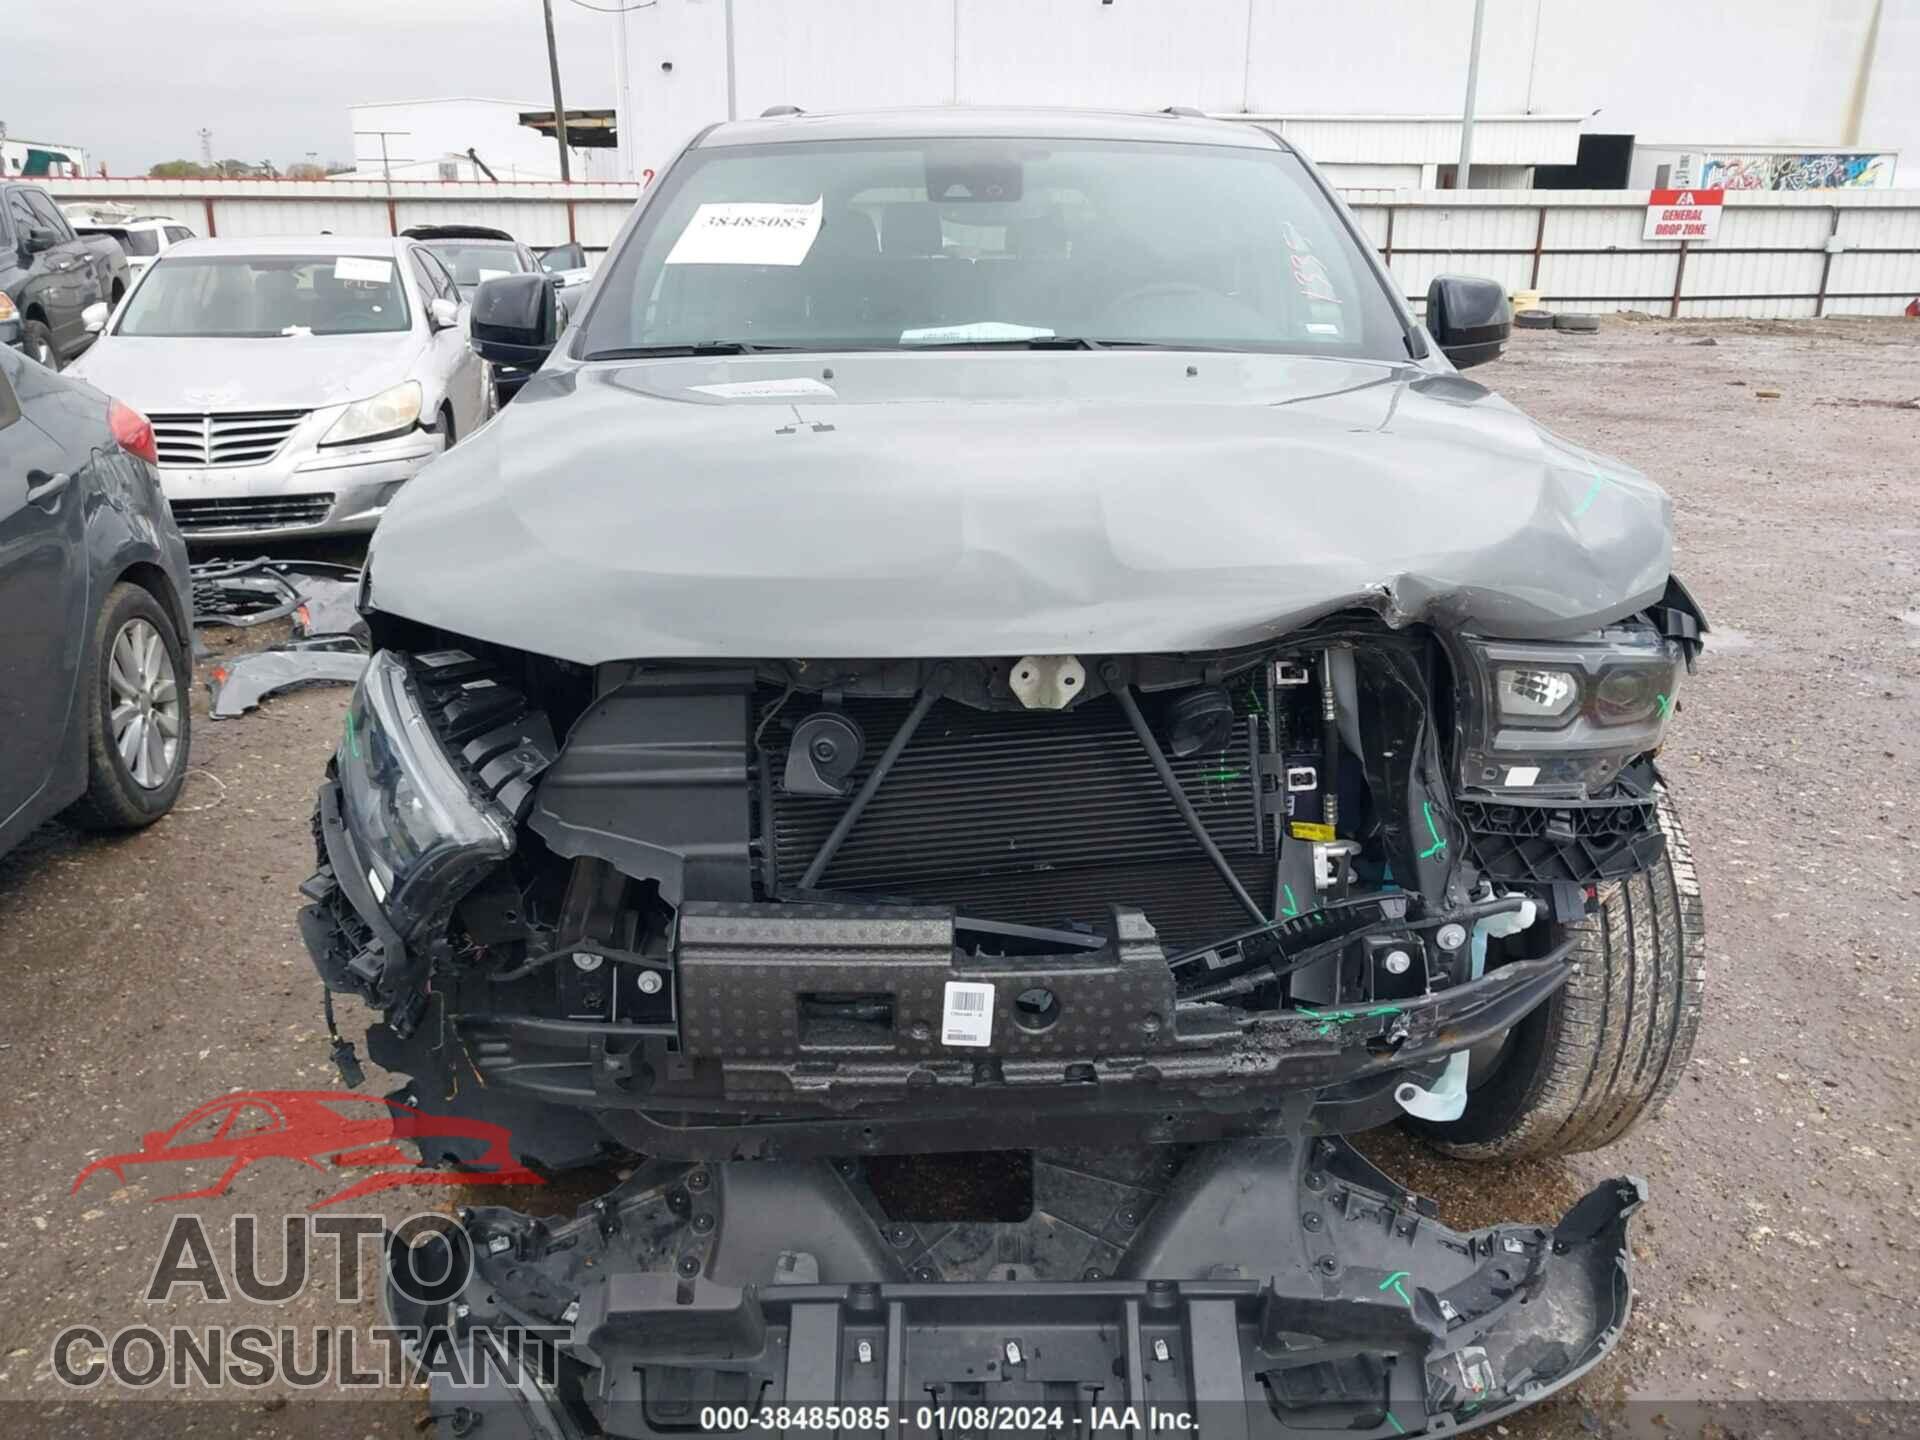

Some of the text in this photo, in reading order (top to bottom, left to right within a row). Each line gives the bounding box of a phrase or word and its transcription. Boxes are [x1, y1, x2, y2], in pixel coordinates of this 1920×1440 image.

[1662, 209, 1703, 221] GENERAL
[1655, 224, 1708, 235] DROP ZONE
